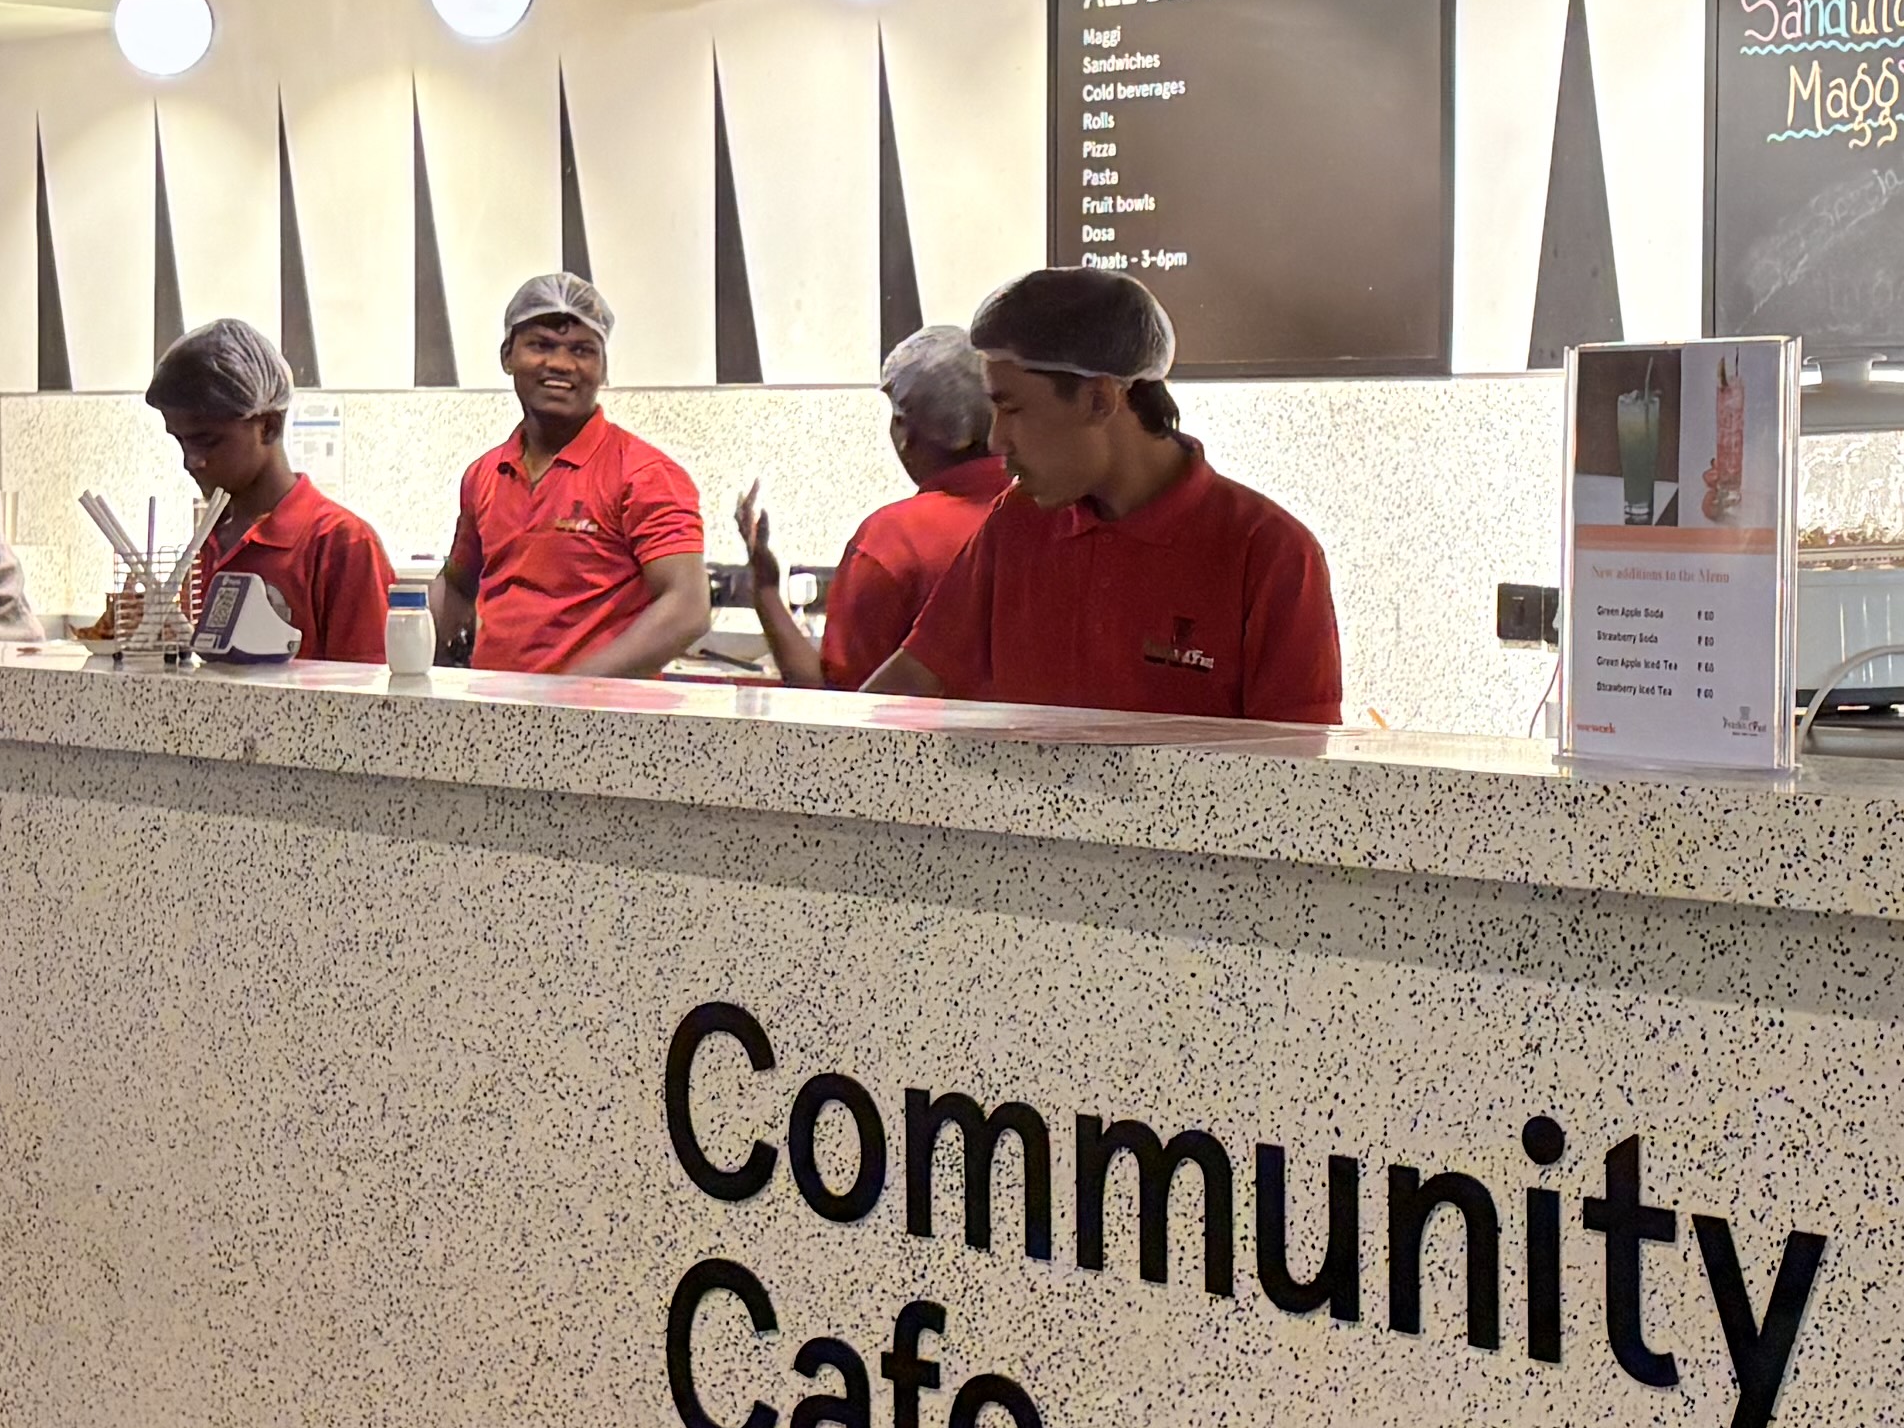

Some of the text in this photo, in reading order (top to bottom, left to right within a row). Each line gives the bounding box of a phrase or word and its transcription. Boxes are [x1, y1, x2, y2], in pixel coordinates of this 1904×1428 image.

[1083, 25, 1121, 48] Maggi
[1083, 52, 1160, 74] Sandwiches
[1082, 80, 1186, 102] Cold beverages
[1082, 111, 1115, 130] Rolls
[1082, 141, 1117, 158] Pizza
[1082, 168, 1119, 186] Pasta
[1082, 193, 1156, 214] Fruit bowls
[1082, 224, 1115, 243] Dosa
[1082, 252, 1128, 270] Chaats
[1141, 249, 1188, 271] 3-6pm
[1665, 569, 1677, 581] to
[1679, 568, 1695, 582] the
[1698, 568, 1730, 583] Menu
[1597, 605, 1619, 617] Green
[1621, 606, 1642, 619] Apple
[1644, 608, 1664, 620] Soda
[1597, 630, 1637, 645] Strawberry
[1639, 632, 1658, 644] Soda
[1597, 655, 1619, 667] Green
[1621, 657, 1642, 670] Apple
[1644, 658, 1661, 670] Iced
[1663, 659, 1678, 671] Tea
[1597, 681, 1637, 696] Strawberry
[1639, 683, 1656, 695] Iced
[1658, 685, 1673, 697] Tea
